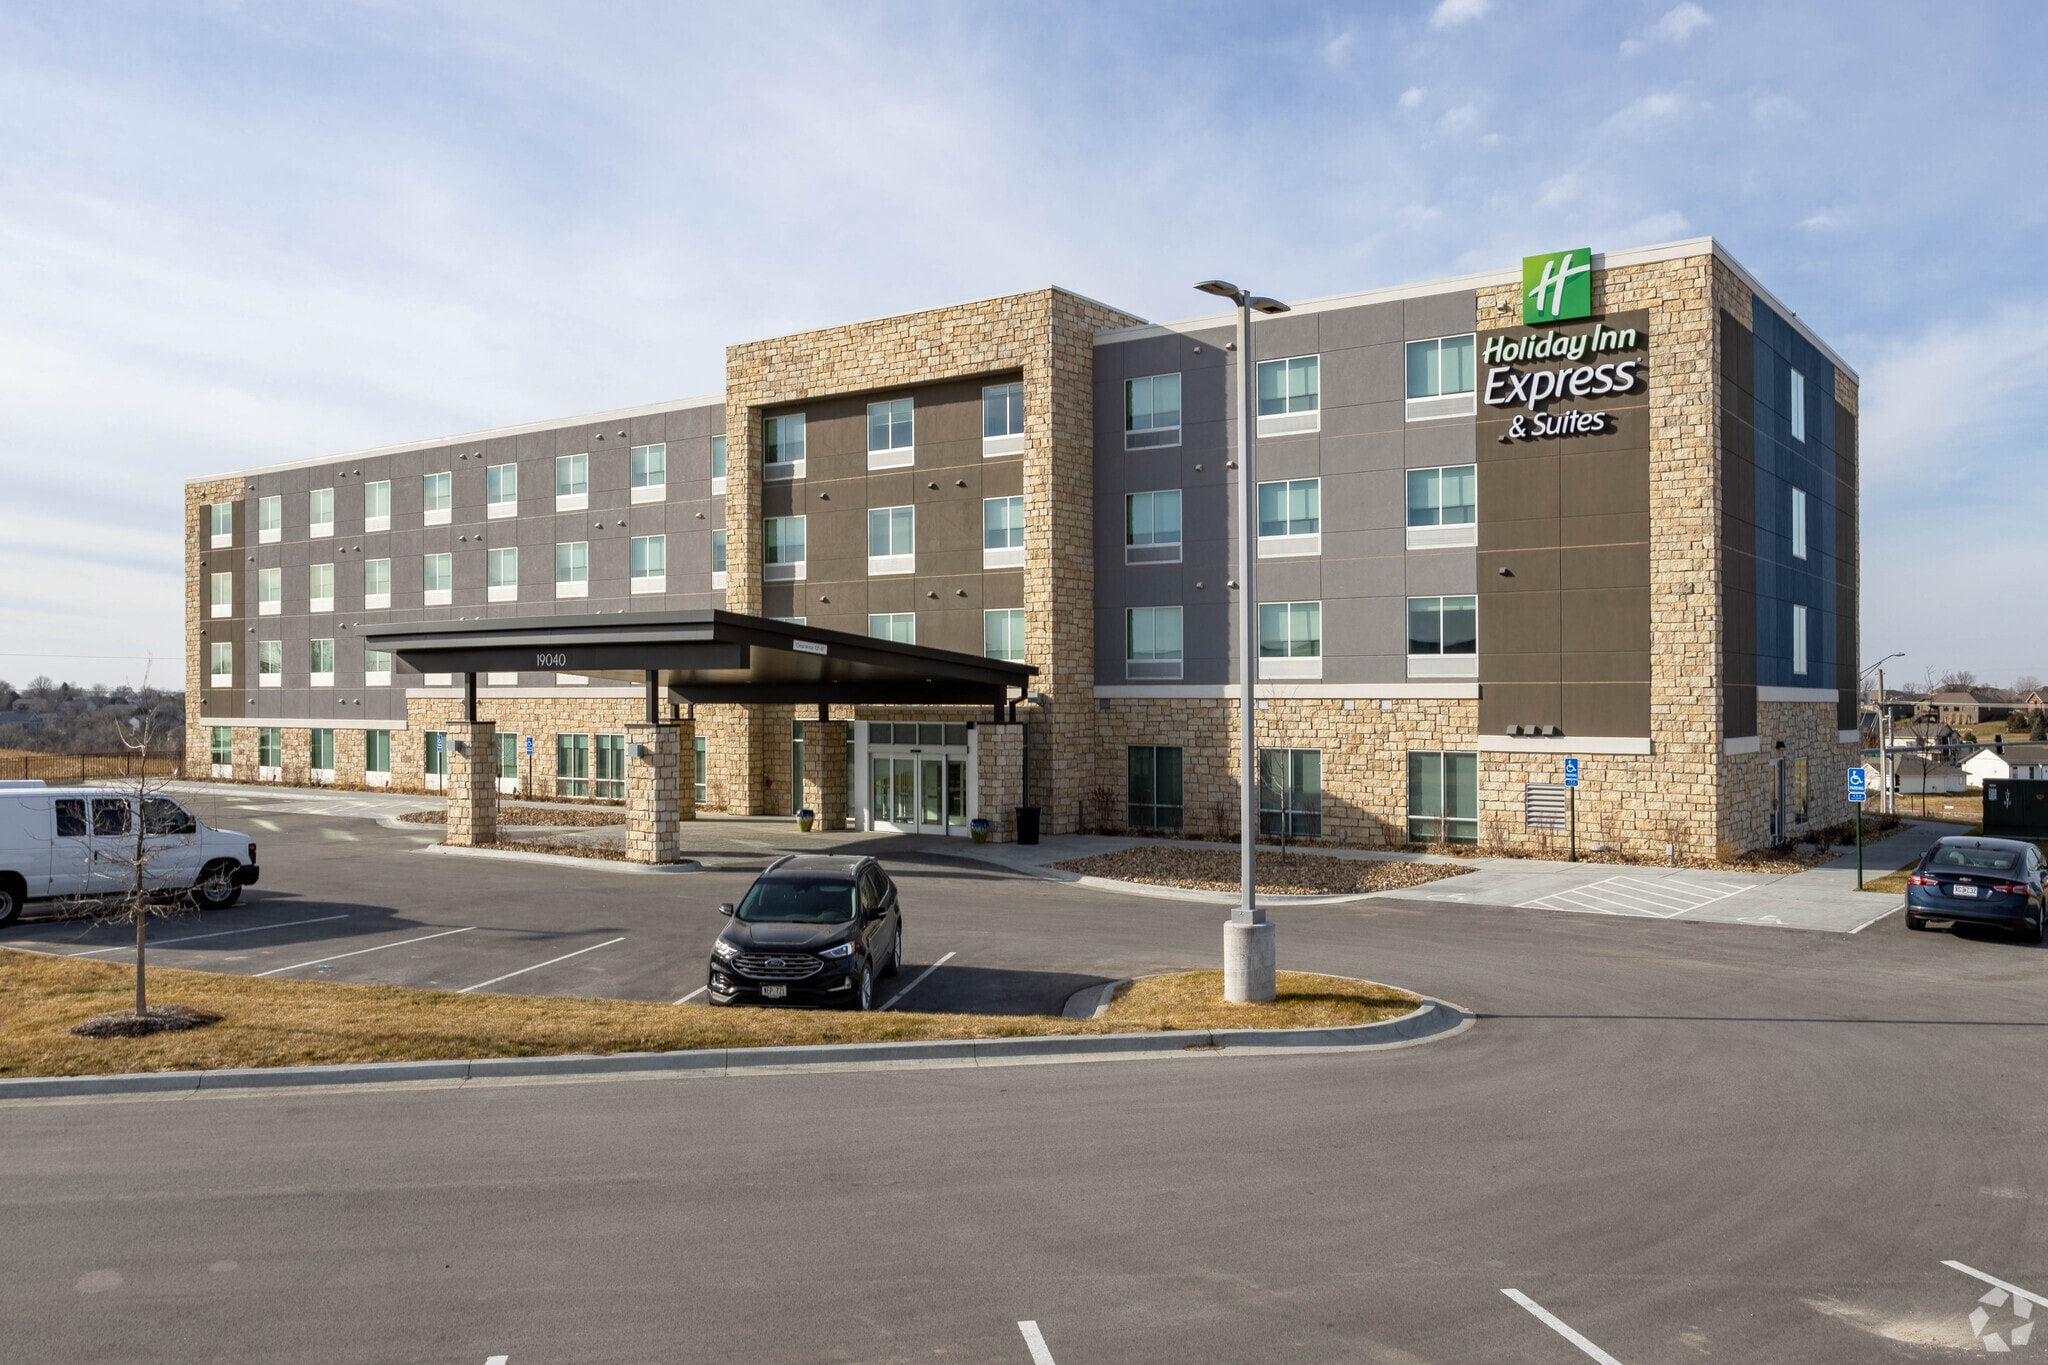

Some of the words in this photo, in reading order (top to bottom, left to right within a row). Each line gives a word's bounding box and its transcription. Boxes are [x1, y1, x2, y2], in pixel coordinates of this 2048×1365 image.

[1482, 330, 1587, 364] Holiday
[1591, 323, 1636, 352] Inn
[1483, 360, 1636, 411] Express
[1508, 414, 1526, 438] &
[1530, 410, 1606, 436] Suites
[536, 653, 567, 666] 19040
